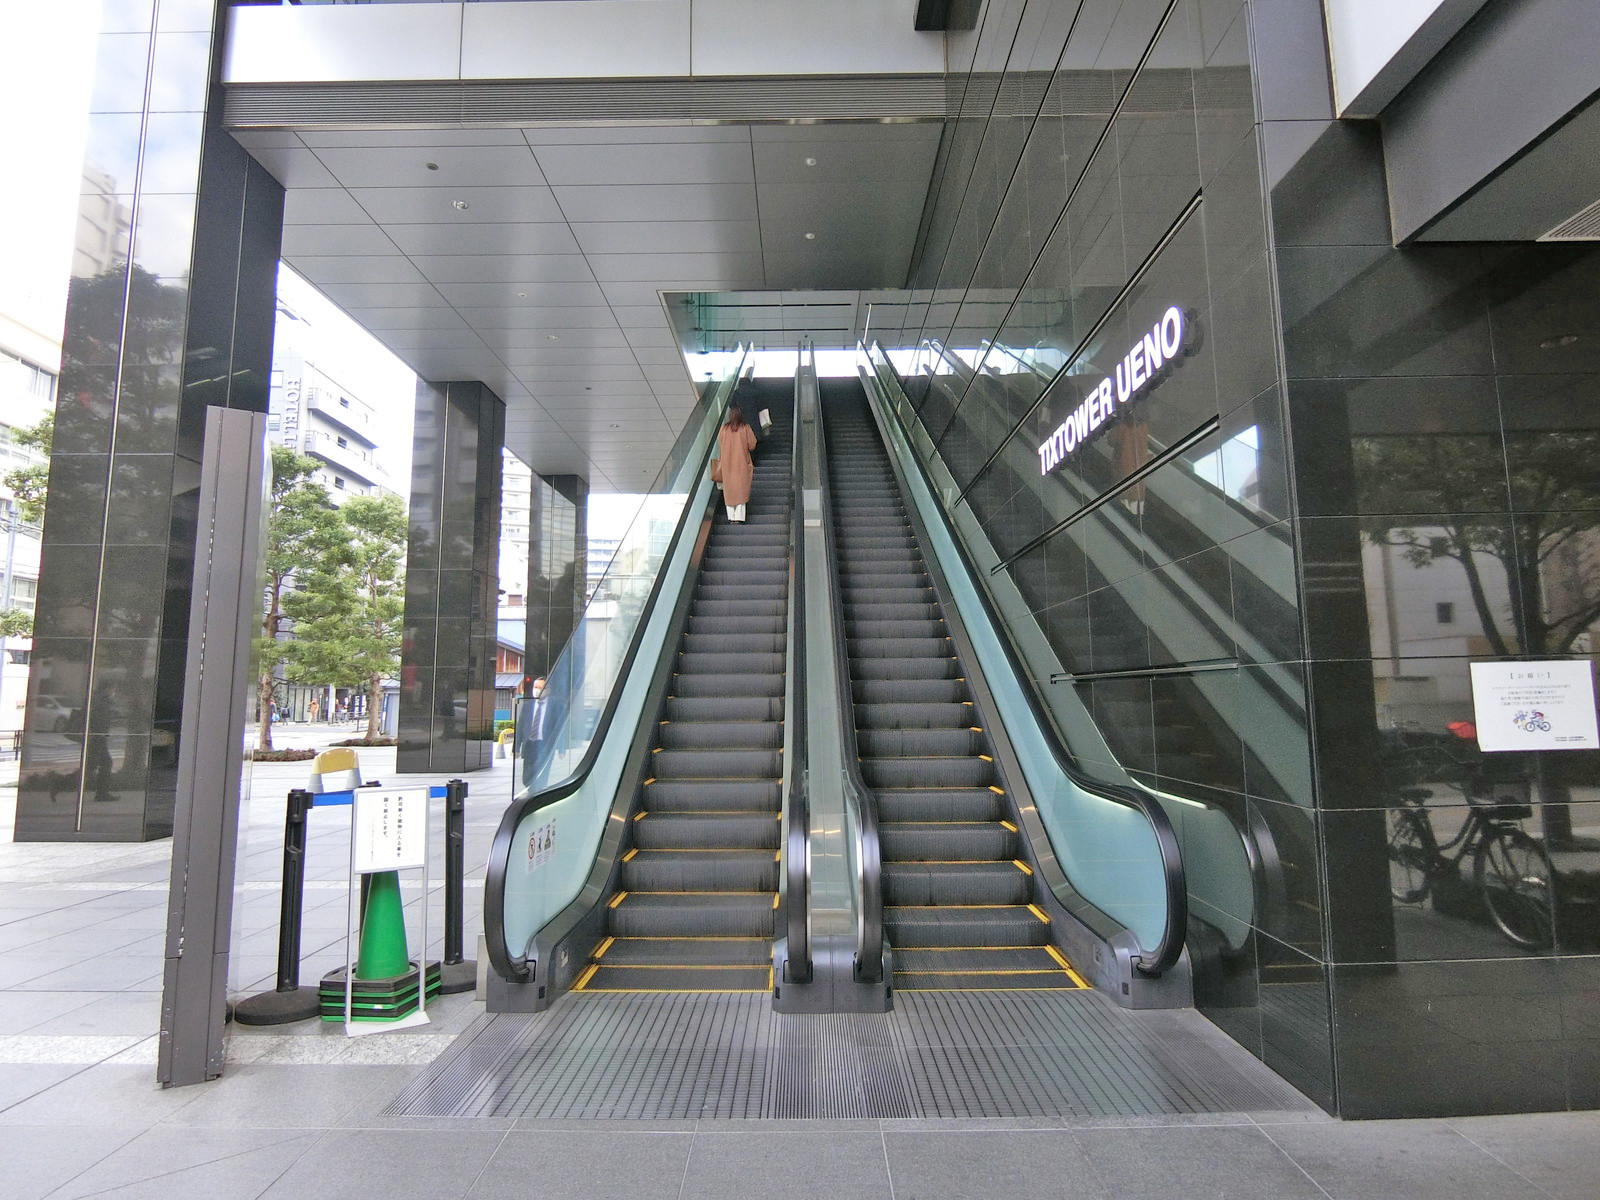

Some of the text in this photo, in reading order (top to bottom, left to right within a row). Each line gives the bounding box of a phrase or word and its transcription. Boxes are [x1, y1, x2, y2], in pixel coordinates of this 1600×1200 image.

[284, 378, 302, 433] HOTEL
[1038, 305, 1183, 476] TIXTOWER UENO
